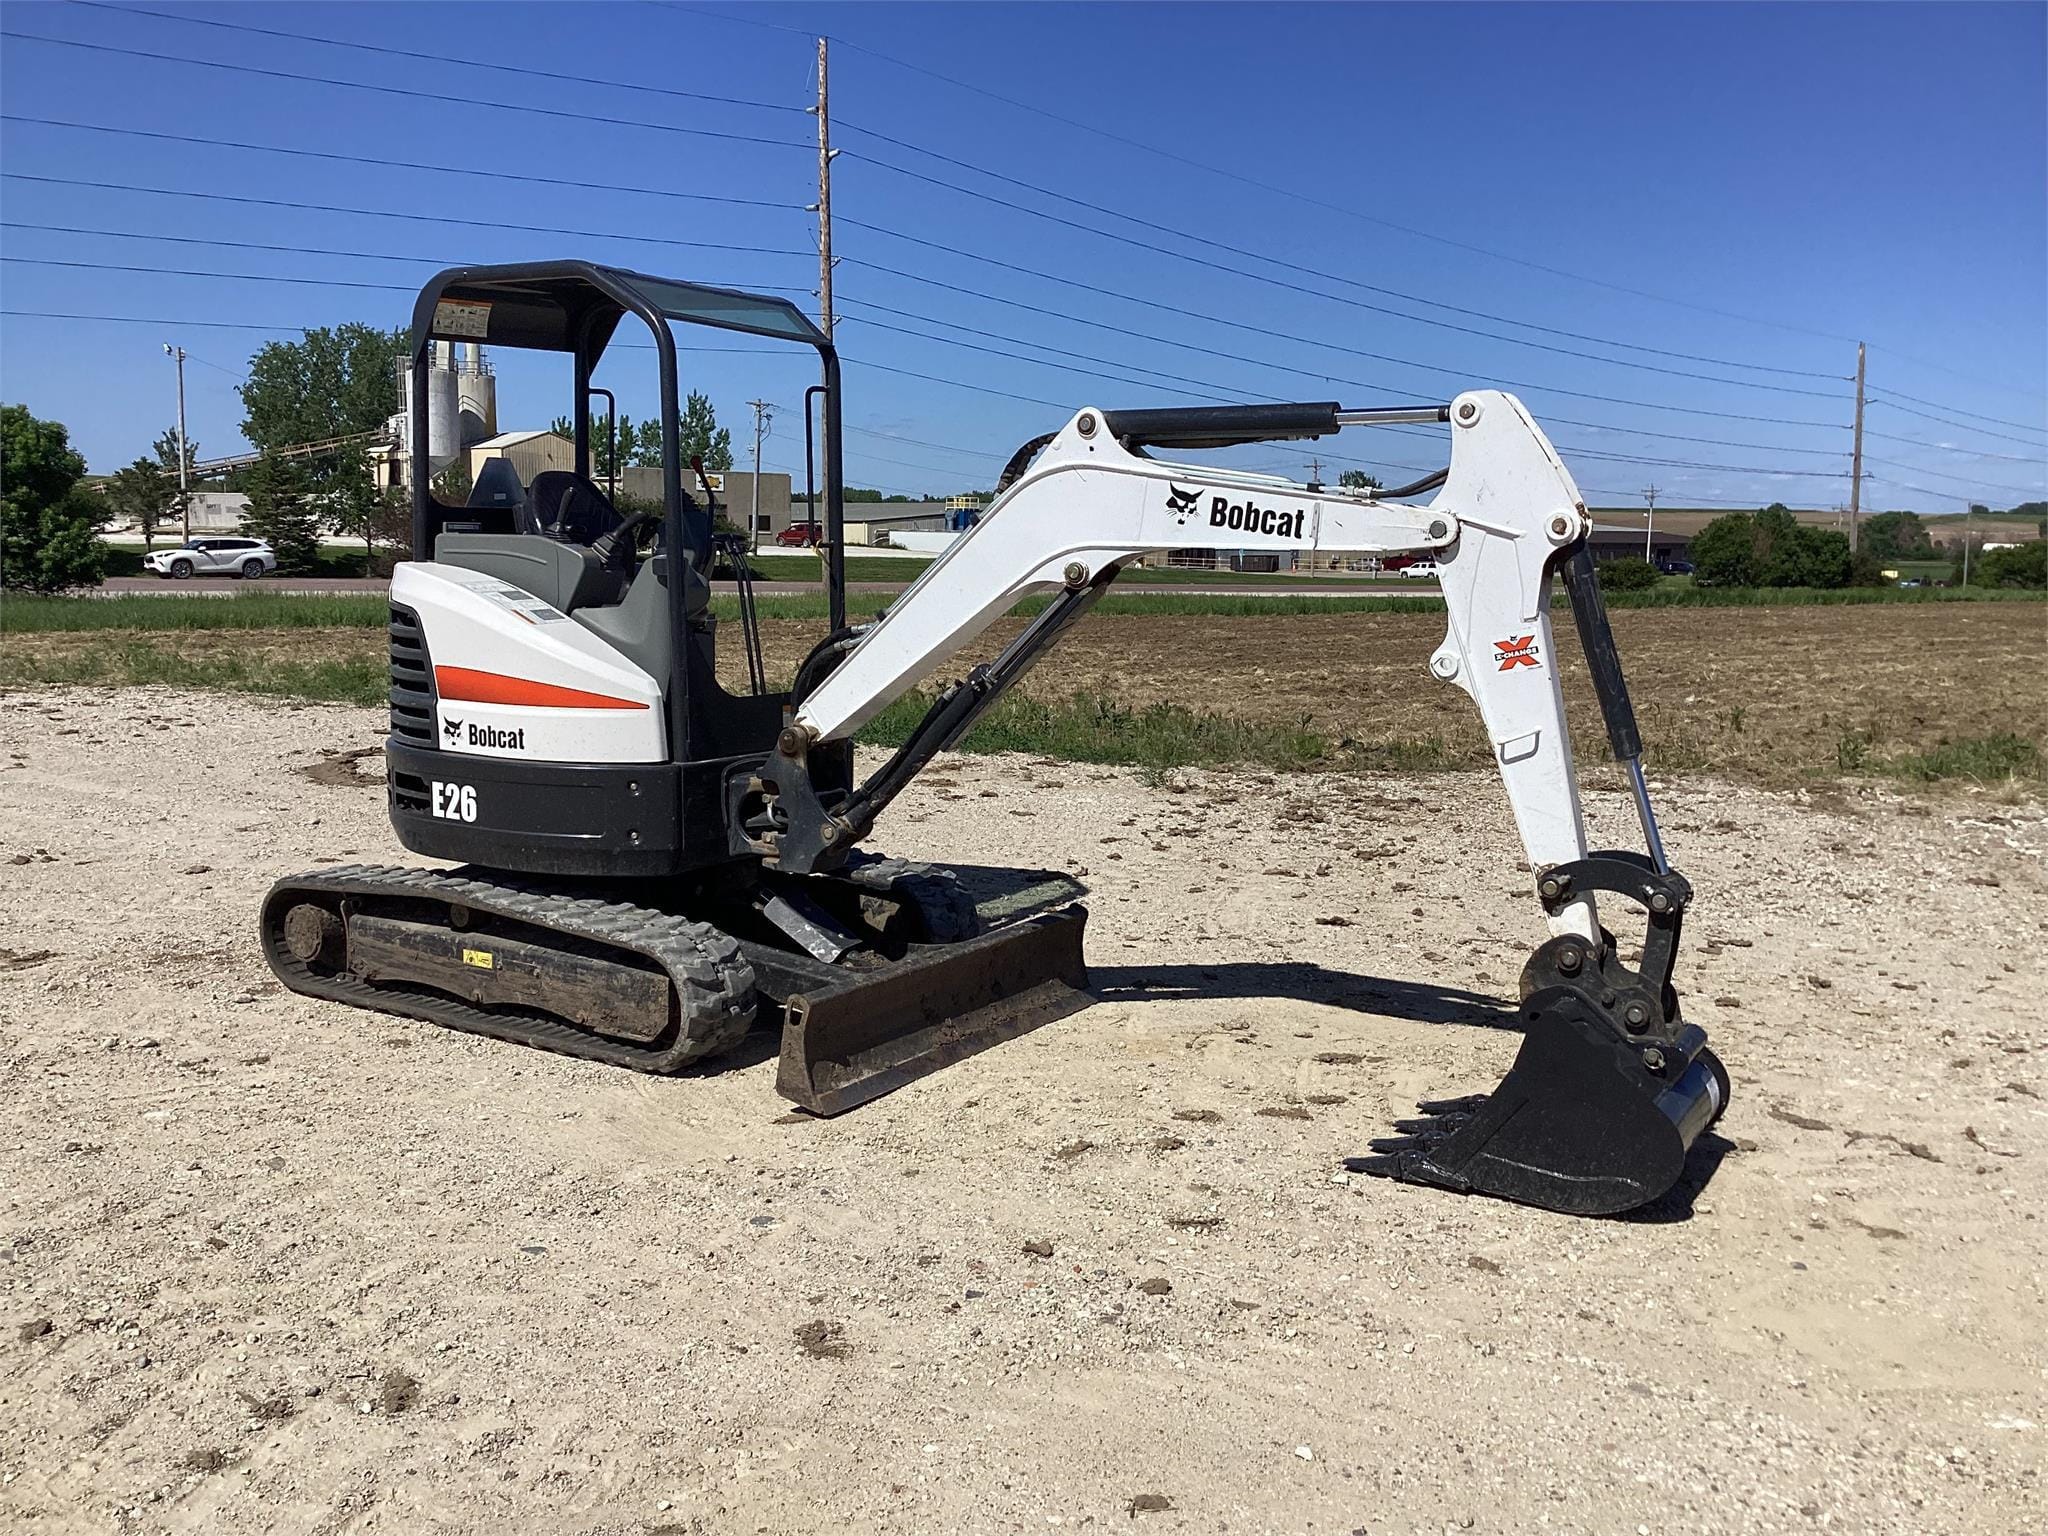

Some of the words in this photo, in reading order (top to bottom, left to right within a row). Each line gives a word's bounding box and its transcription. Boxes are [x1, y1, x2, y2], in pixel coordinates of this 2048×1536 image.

[1209, 496, 1304, 539] Bobcat
[1495, 646, 1539, 661] X-CHANGE
[468, 723, 525, 750] Bobcat
[431, 781, 477, 823] E26
